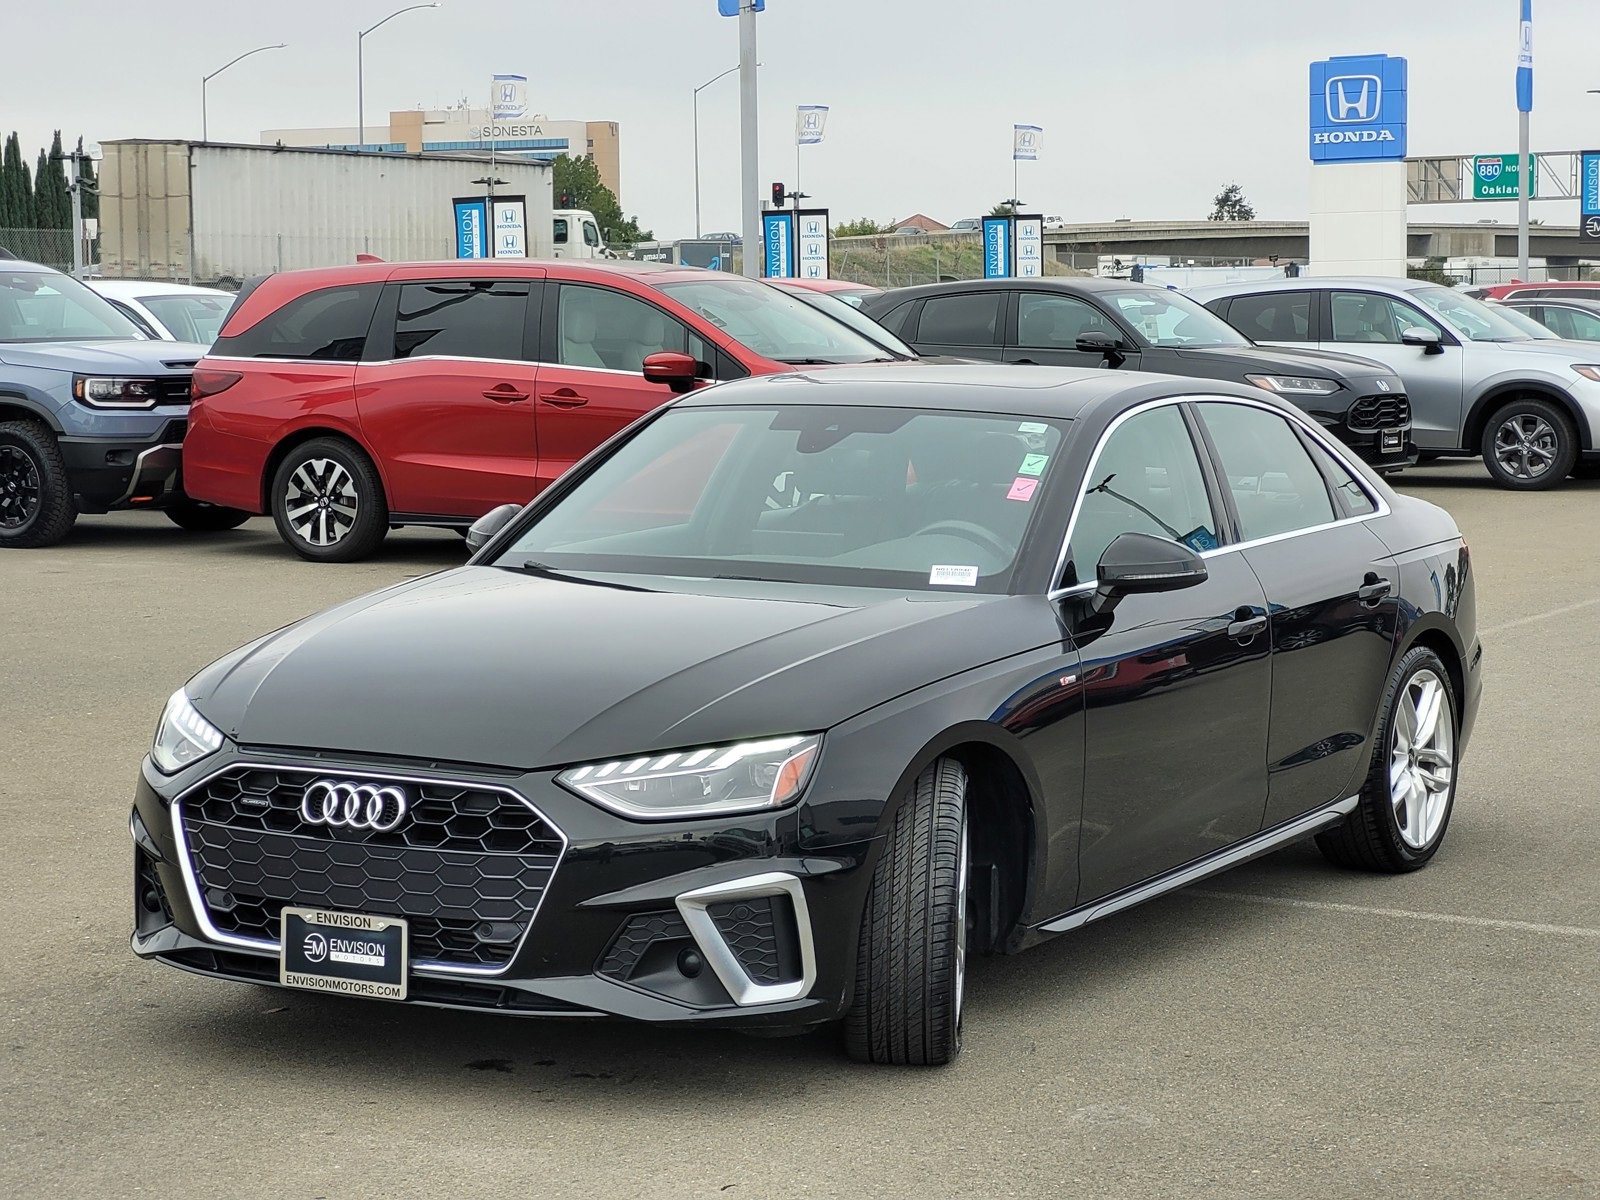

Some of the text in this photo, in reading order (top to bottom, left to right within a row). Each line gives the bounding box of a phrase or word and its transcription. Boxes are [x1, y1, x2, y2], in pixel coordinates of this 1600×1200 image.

[482, 125, 543, 138] SONESTA
[1313, 130, 1396, 144] HONDA
[1479, 165, 1500, 176] 880
[1481, 185, 1519, 195] Oaklan
[1588, 159, 1598, 211] ENVISION
[770, 221, 780, 278] ENVISION
[988, 224, 998, 276] ENVISION
[316, 912, 371, 928] ENVISION
[329, 938, 386, 957] ENVISION
[334, 953, 381, 964] MOTORS
[286, 974, 401, 998] ENVISIONMOTORS.COM
